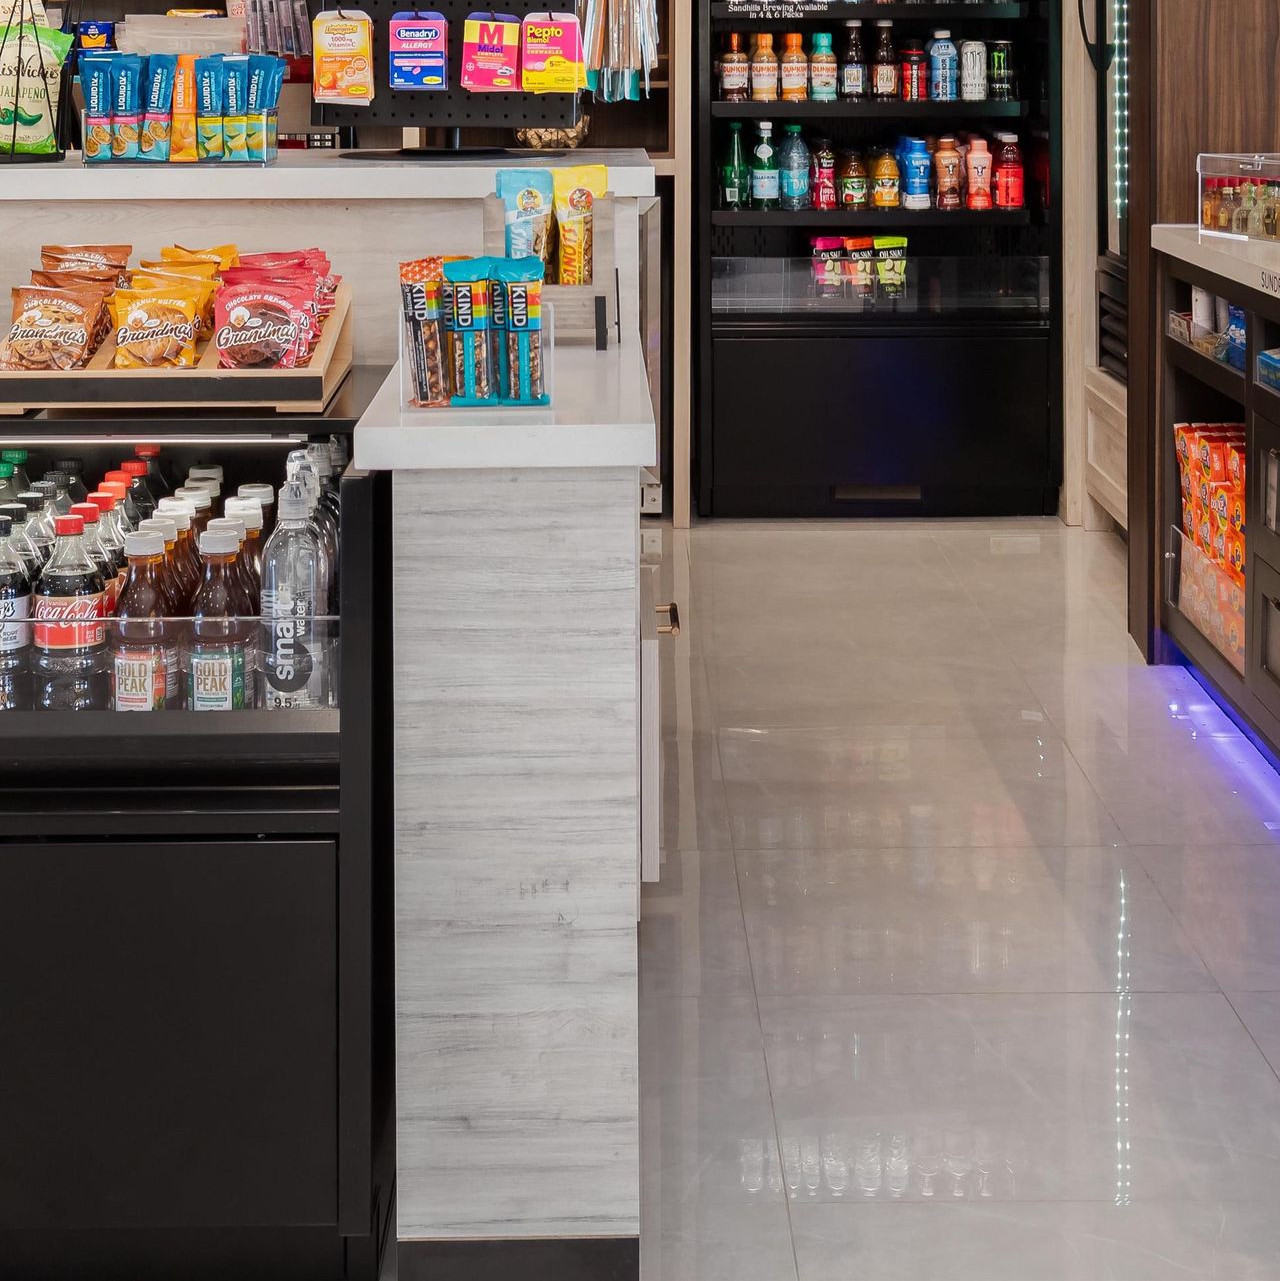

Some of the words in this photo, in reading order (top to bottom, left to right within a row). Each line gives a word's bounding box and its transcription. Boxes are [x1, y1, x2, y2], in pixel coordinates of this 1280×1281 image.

[728, 4, 761, 13] Sandhills
[763, 3, 795, 13] Brewing
[796, 3, 829, 12] Available
[766, 11, 772, 19] &
[782, 11, 804, 19] Packs
[399, 29, 436, 40] Benadryl
[479, 23, 505, 45] M
[527, 25, 563, 38] Pepto
[527, 36, 549, 44] Bismol
[477, 44, 503, 53] Midol
[118, 85, 126, 110] LIQUID
[150, 82, 159, 107] LIQUID
[203, 86, 211, 111] LIQUID
[248, 83, 258, 108] LIQUID
[23, 298, 66, 311] CHOCOLATE
[225, 294, 262, 311] CHOCOLATE
[412, 283, 427, 321] KIND
[457, 285, 472, 327] KIND
[512, 285, 527, 327] KIND
[8, 323, 87, 346] Grandma's
[116, 321, 193, 349] Grandma's
[216, 321, 299, 350] Grandma's
[35, 599, 100, 629] Coca-Cola
[296, 599, 306, 637] water
[275, 600, 295, 680] smart
[195, 662, 228, 677] GOLD
[118, 677, 148, 692] PEAK
[196, 677, 228, 692] PEAK
[274, 697, 292, 708] 9.5
